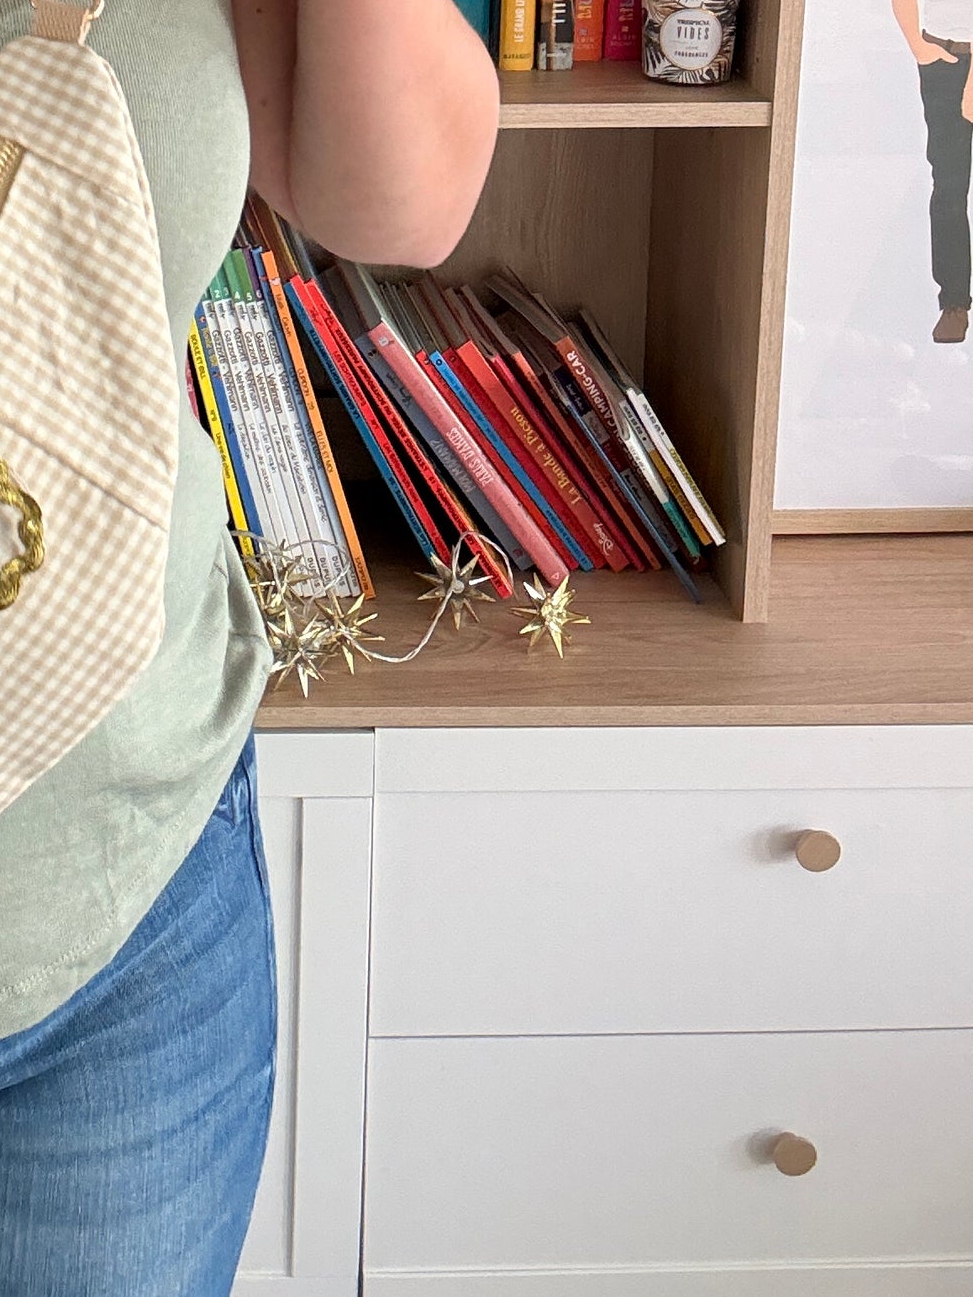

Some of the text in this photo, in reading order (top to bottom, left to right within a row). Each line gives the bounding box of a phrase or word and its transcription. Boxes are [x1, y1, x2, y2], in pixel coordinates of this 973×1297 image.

[507, 403, 539, 446] Picsou
[532, 441, 546, 454] à
[540, 449, 571, 489] Bande
[565, 485, 583, 506] La
